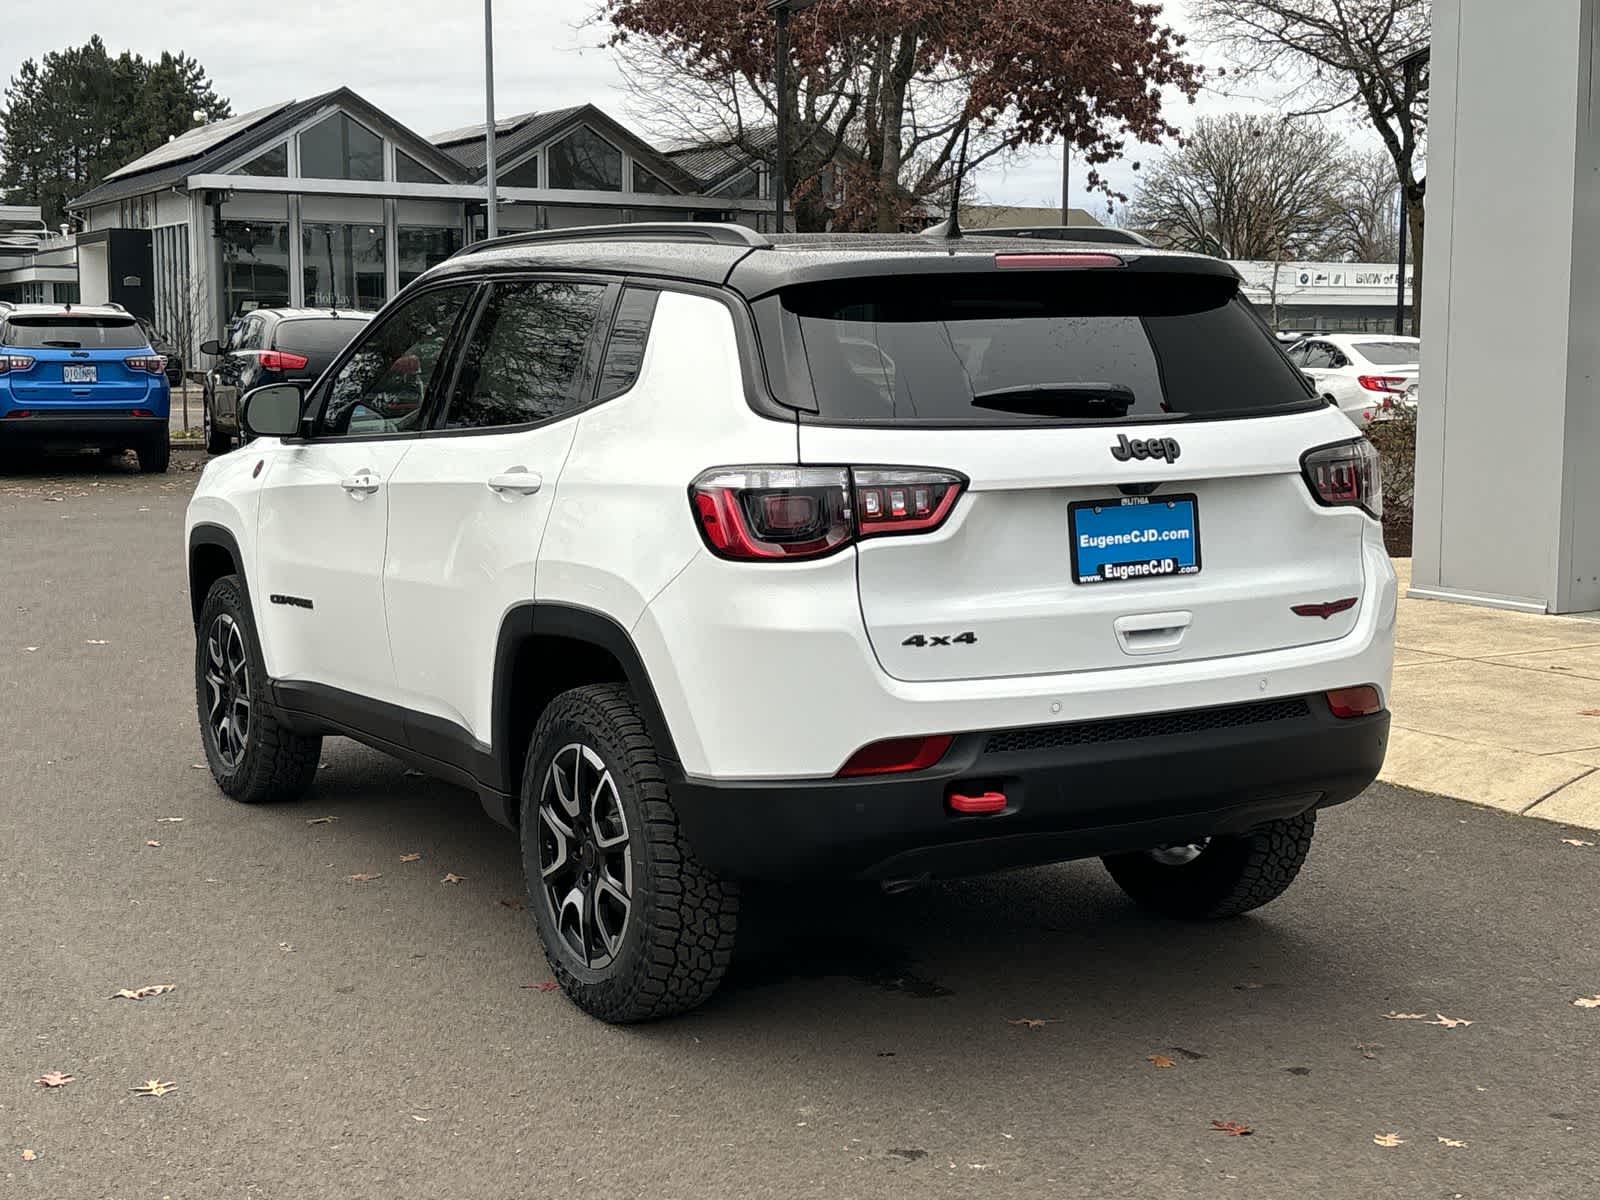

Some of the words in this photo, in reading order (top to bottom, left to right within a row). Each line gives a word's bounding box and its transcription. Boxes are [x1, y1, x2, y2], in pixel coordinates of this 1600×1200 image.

[1355, 272, 1382, 285] BMW
[1383, 273, 1394, 285] of
[1110, 433, 1181, 464] Jeep
[1079, 528, 1190, 549] EugeneCJD.com
[1104, 558, 1174, 580] EugeneCJD
[901, 631, 978, 648] 4x4
